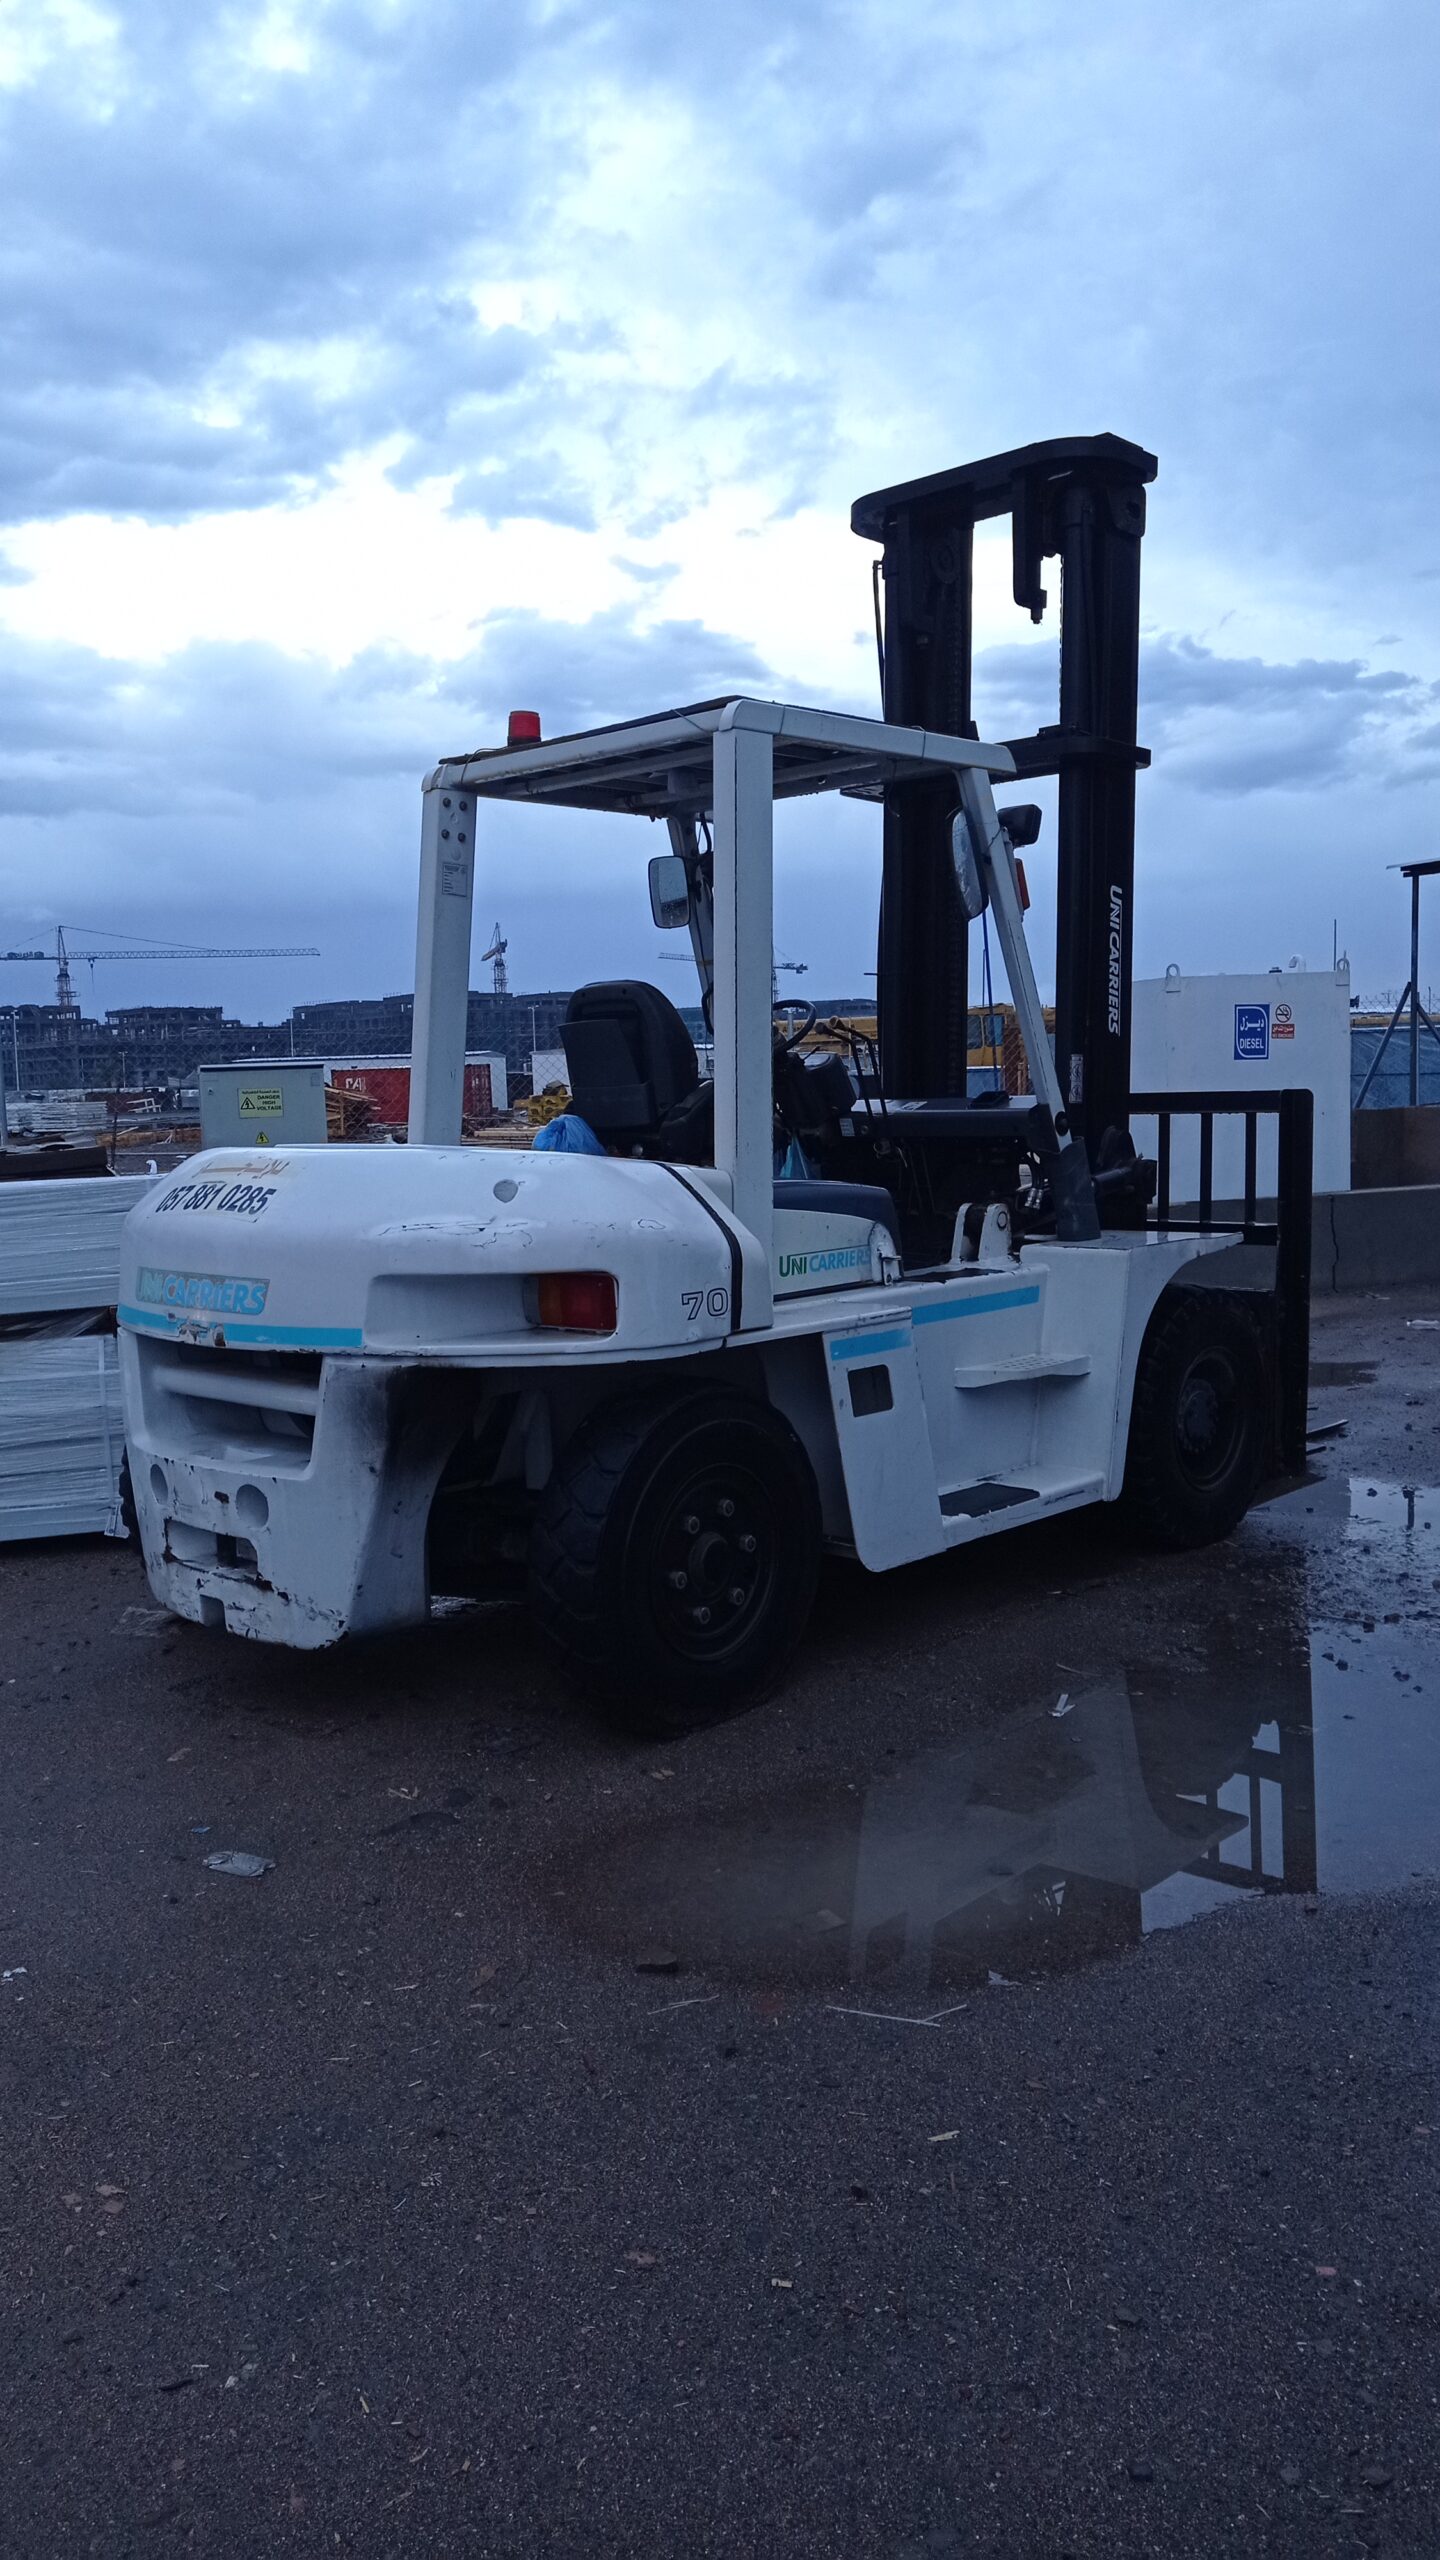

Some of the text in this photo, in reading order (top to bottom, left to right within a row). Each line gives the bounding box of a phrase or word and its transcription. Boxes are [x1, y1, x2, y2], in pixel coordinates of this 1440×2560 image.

[1240, 1016, 1264, 1031] ديزل
[1240, 1038, 1264, 1049] DIESEL
[155, 1183, 277, 1215] 057 881 0285
[681, 1287, 729, 1320] 70
